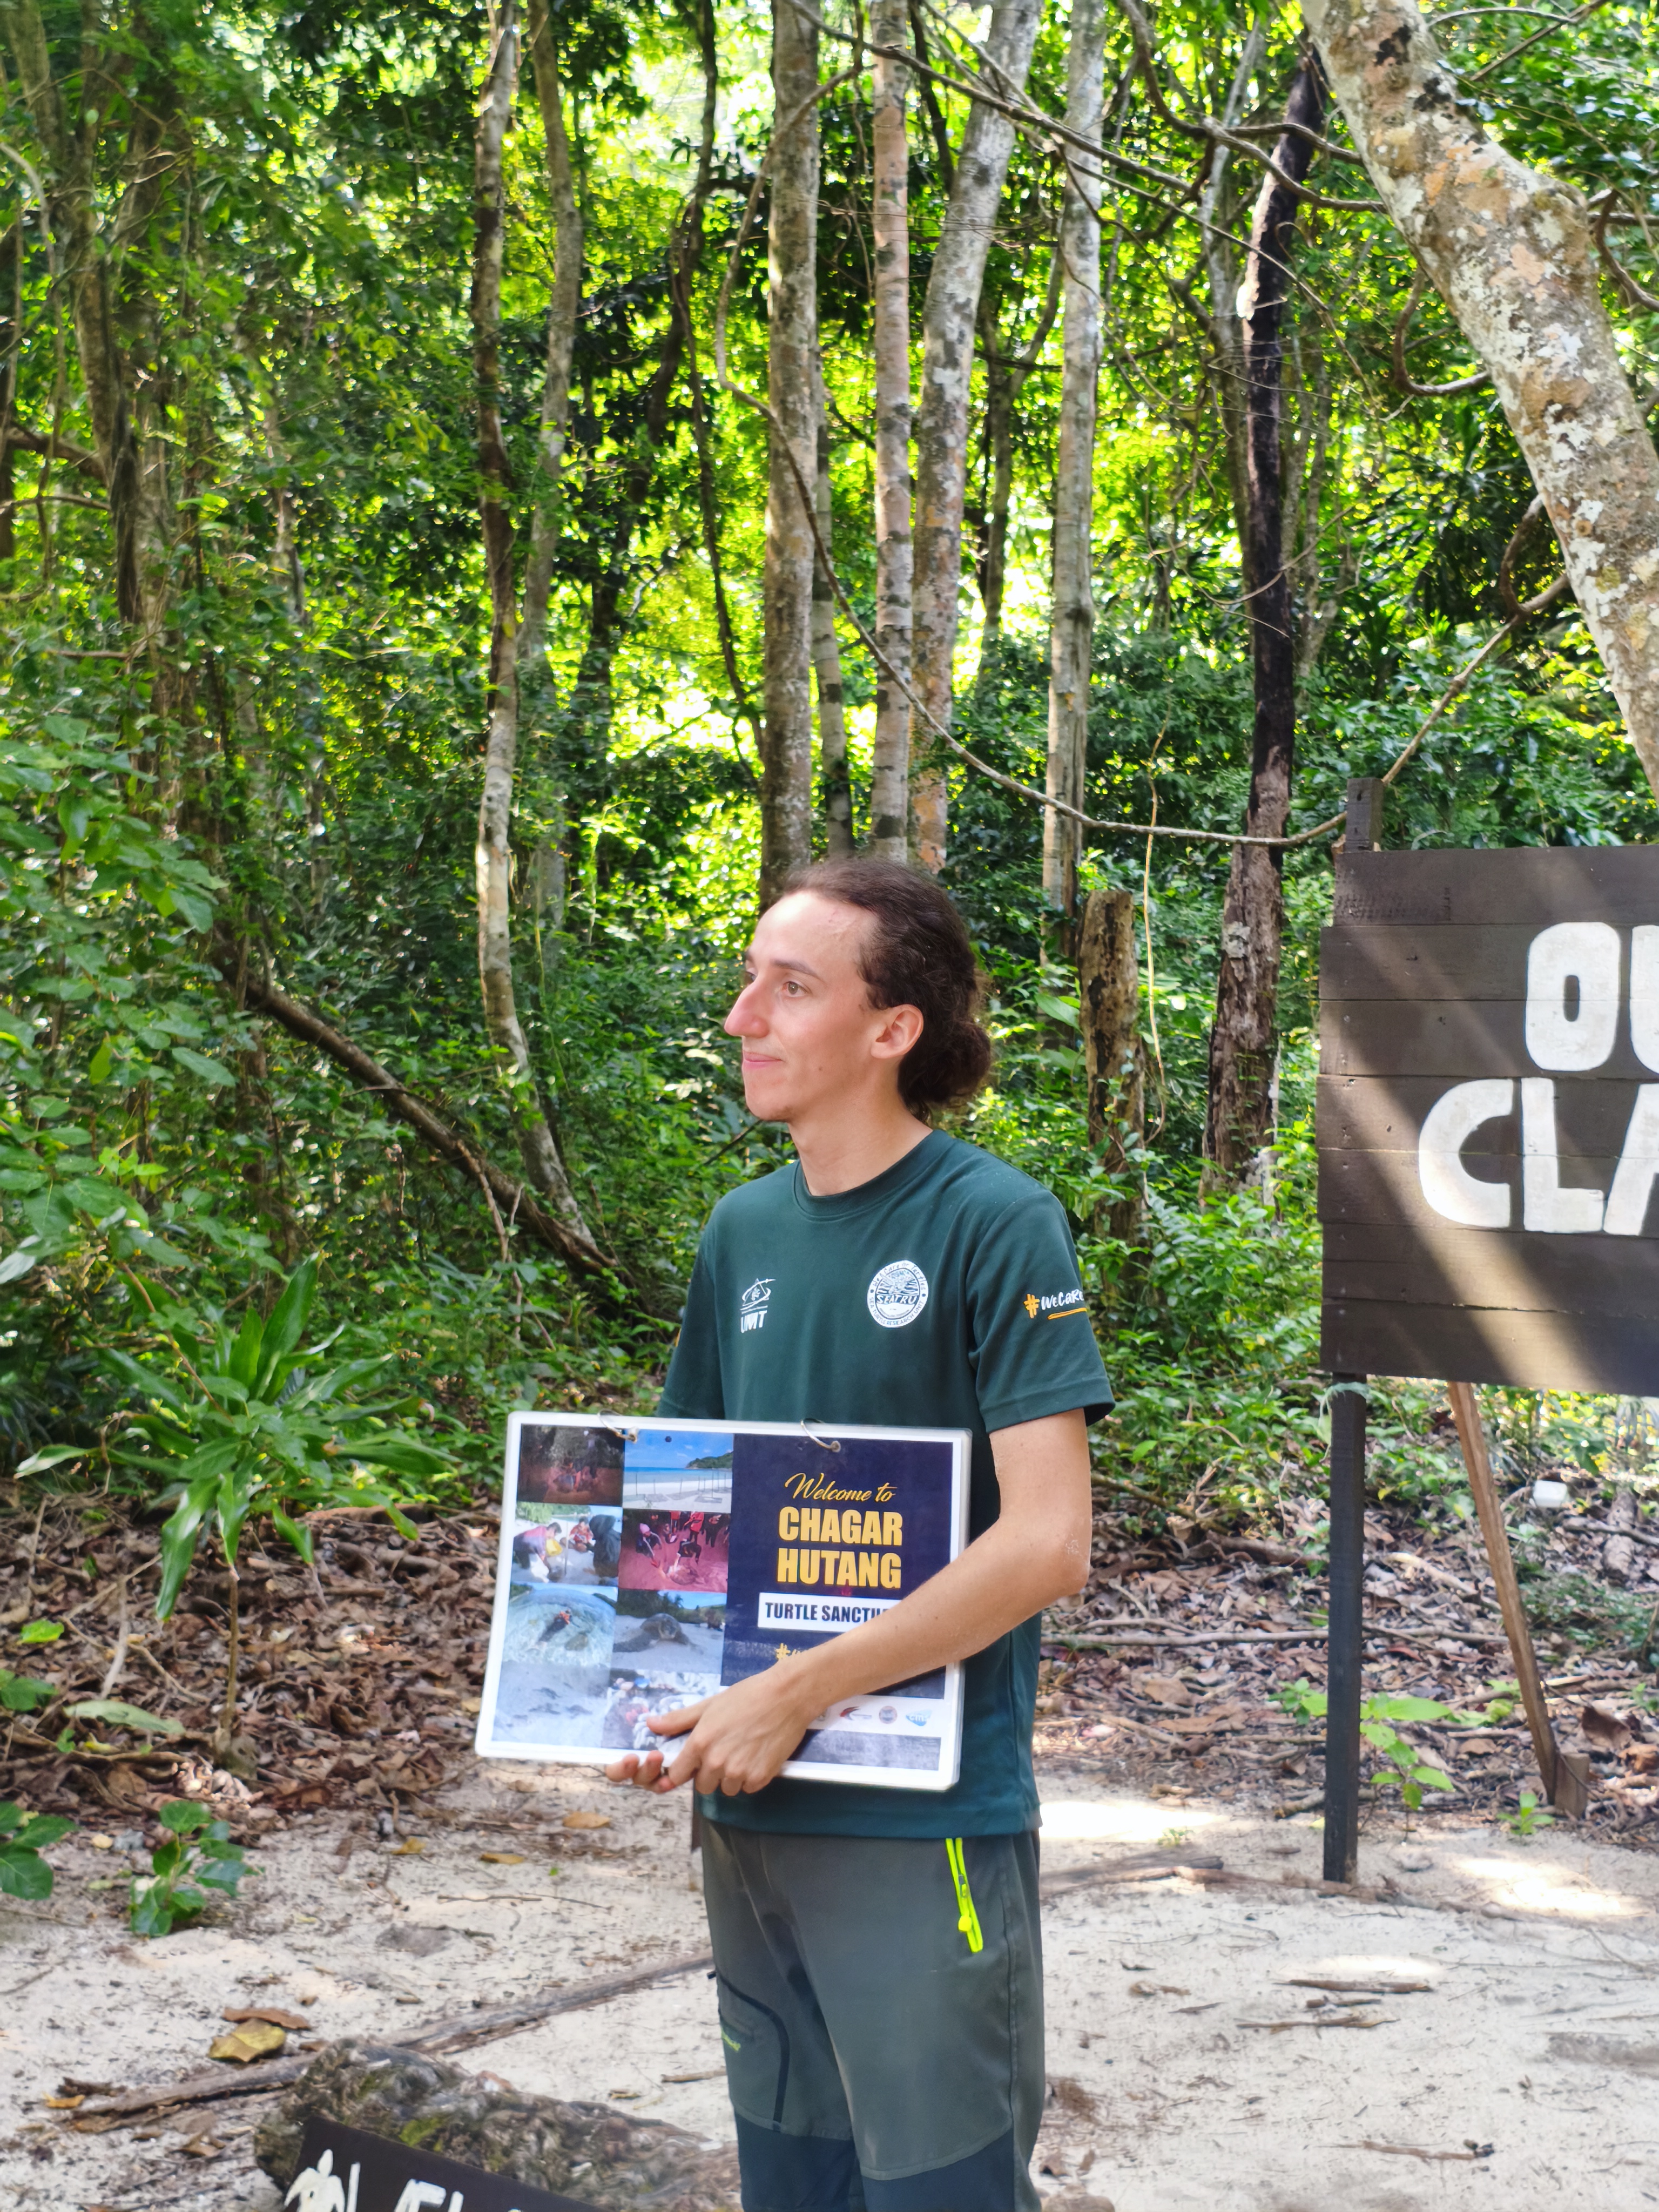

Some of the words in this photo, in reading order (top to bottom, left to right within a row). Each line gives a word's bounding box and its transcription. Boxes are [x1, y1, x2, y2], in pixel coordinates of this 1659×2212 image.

[876, 1294, 918, 1305] SEATRU
[740, 1310, 767, 1333] UMT
[872, 1309, 886, 1325] TURTLE
[886, 1313, 914, 1326] RESEARCH
[913, 1301, 925, 1314] UNIT
[785, 1473, 872, 1501] Welcome
[875, 1482, 898, 1502] to
[779, 1506, 902, 1546] CHAGAR
[777, 1548, 901, 1588] HUTANG
[765, 1602, 818, 1620] TURTLE
[821, 1604, 889, 1623] SANCT
